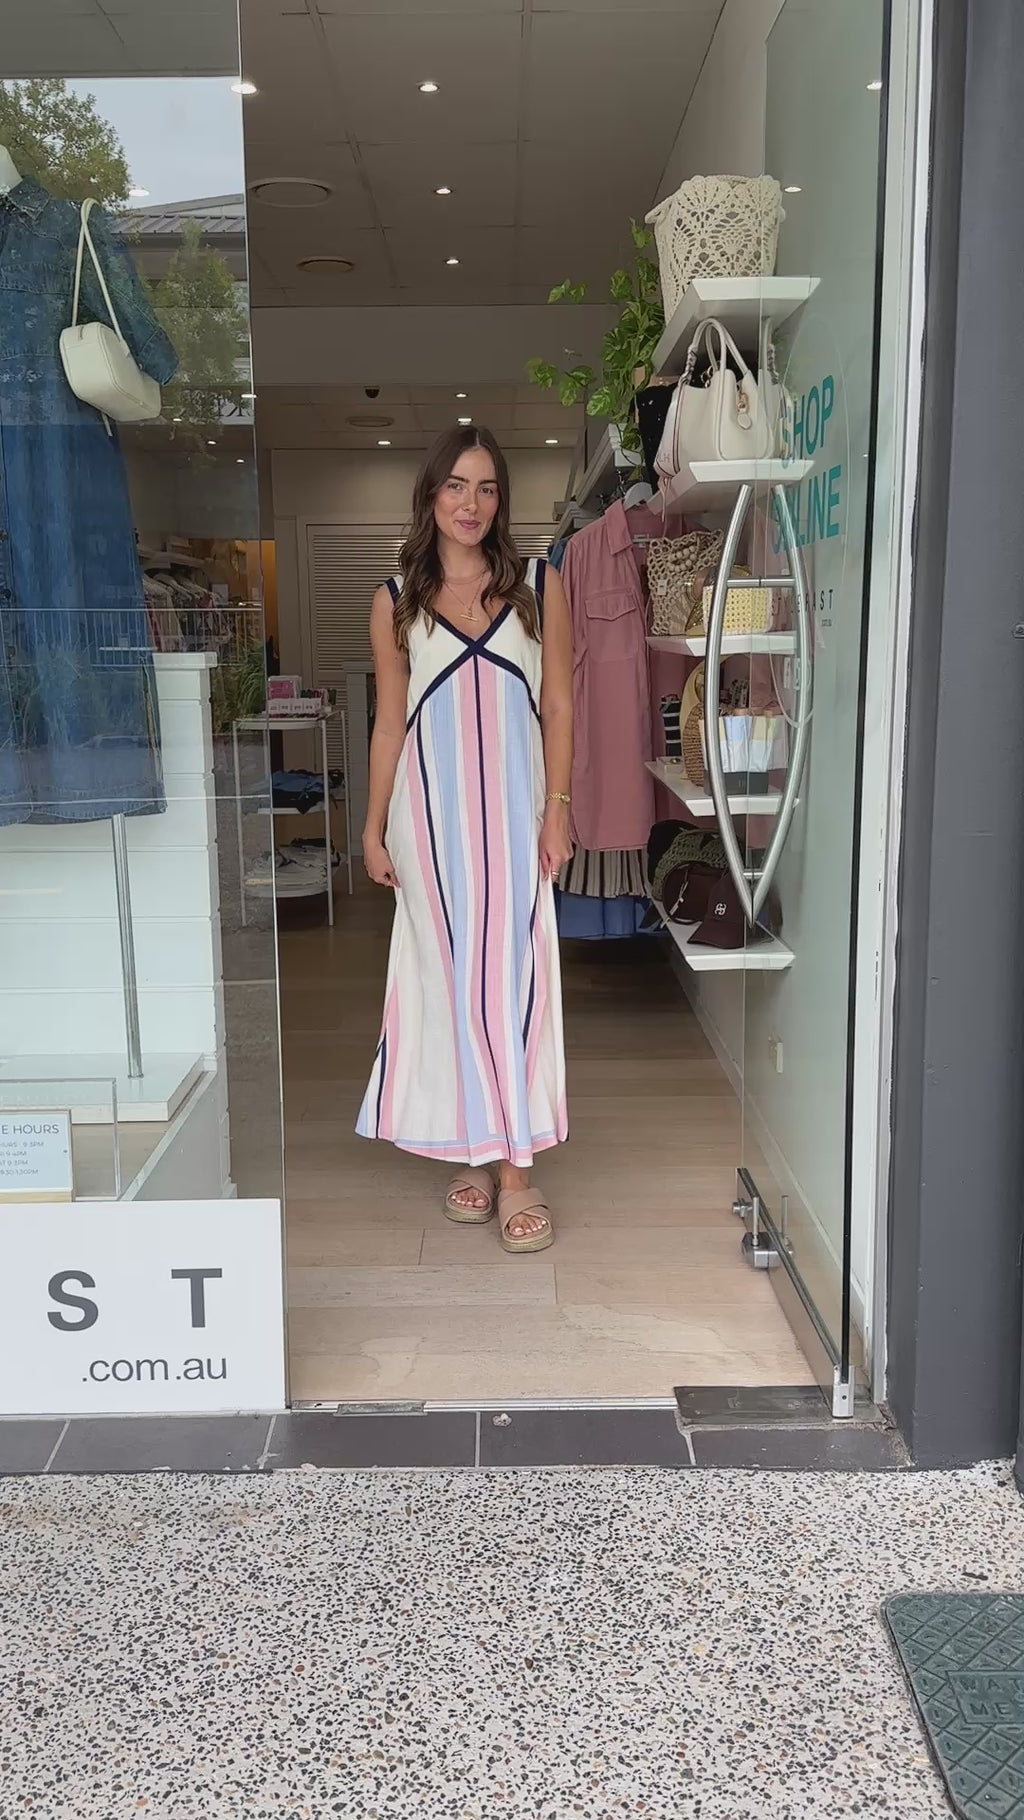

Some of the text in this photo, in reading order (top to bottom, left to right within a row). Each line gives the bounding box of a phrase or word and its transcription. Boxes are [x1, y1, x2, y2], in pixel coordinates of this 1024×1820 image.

[780, 374, 834, 469] SHOP
[14, 1123, 60, 1135] HOURS
[82, 1357, 228, 1382] .com.au
[969, 1702, 1024, 1716] ME
